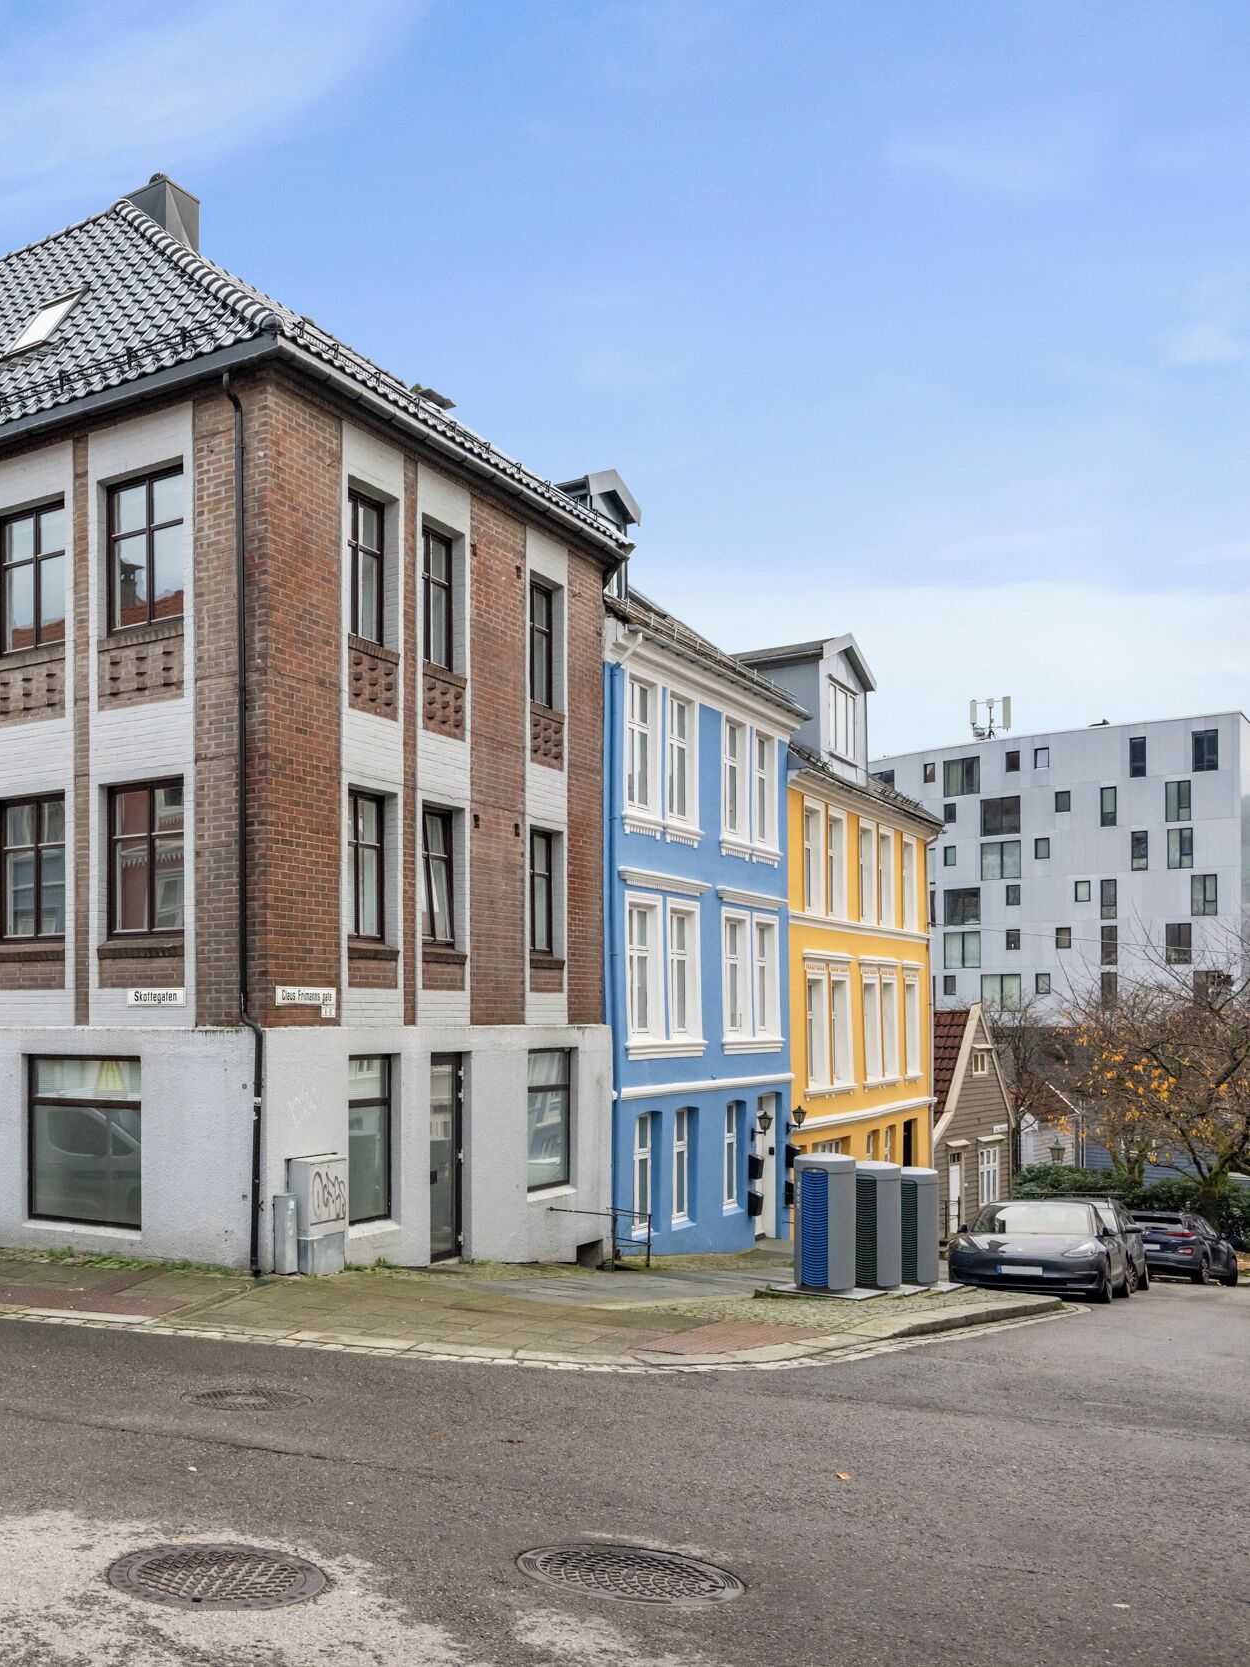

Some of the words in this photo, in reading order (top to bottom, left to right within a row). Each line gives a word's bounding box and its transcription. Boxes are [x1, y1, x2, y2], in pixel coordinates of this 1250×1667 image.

[134, 991, 177, 1004] Skottegaten
[282, 989, 296, 1001] Claus
[322, 992, 332, 1004] gate
